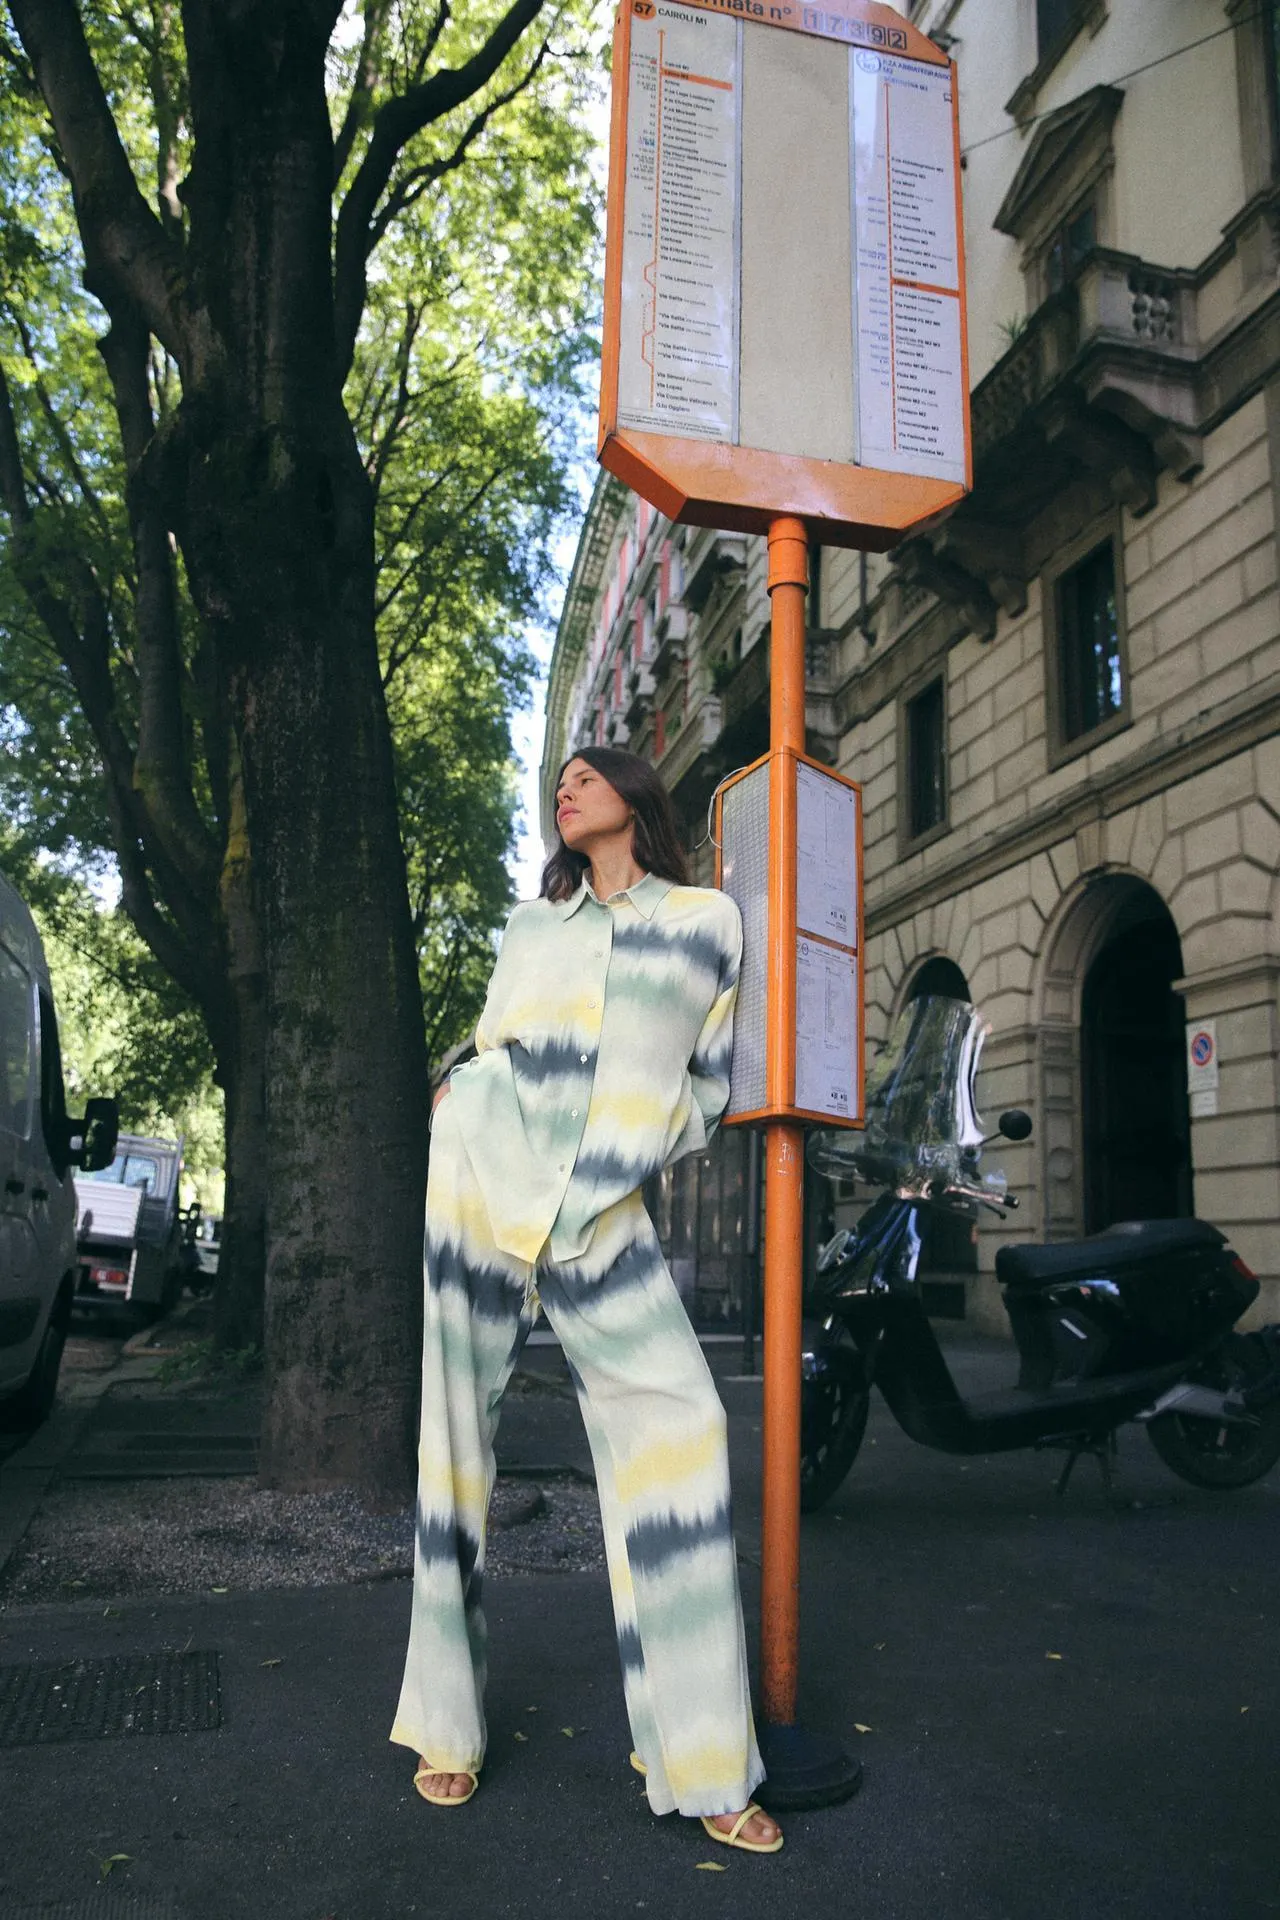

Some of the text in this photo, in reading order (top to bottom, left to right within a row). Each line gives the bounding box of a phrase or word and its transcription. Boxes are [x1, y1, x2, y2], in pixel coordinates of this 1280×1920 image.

[634, 1, 650, 16] 57
[658, 8, 707, 26] CAIROLI M1
